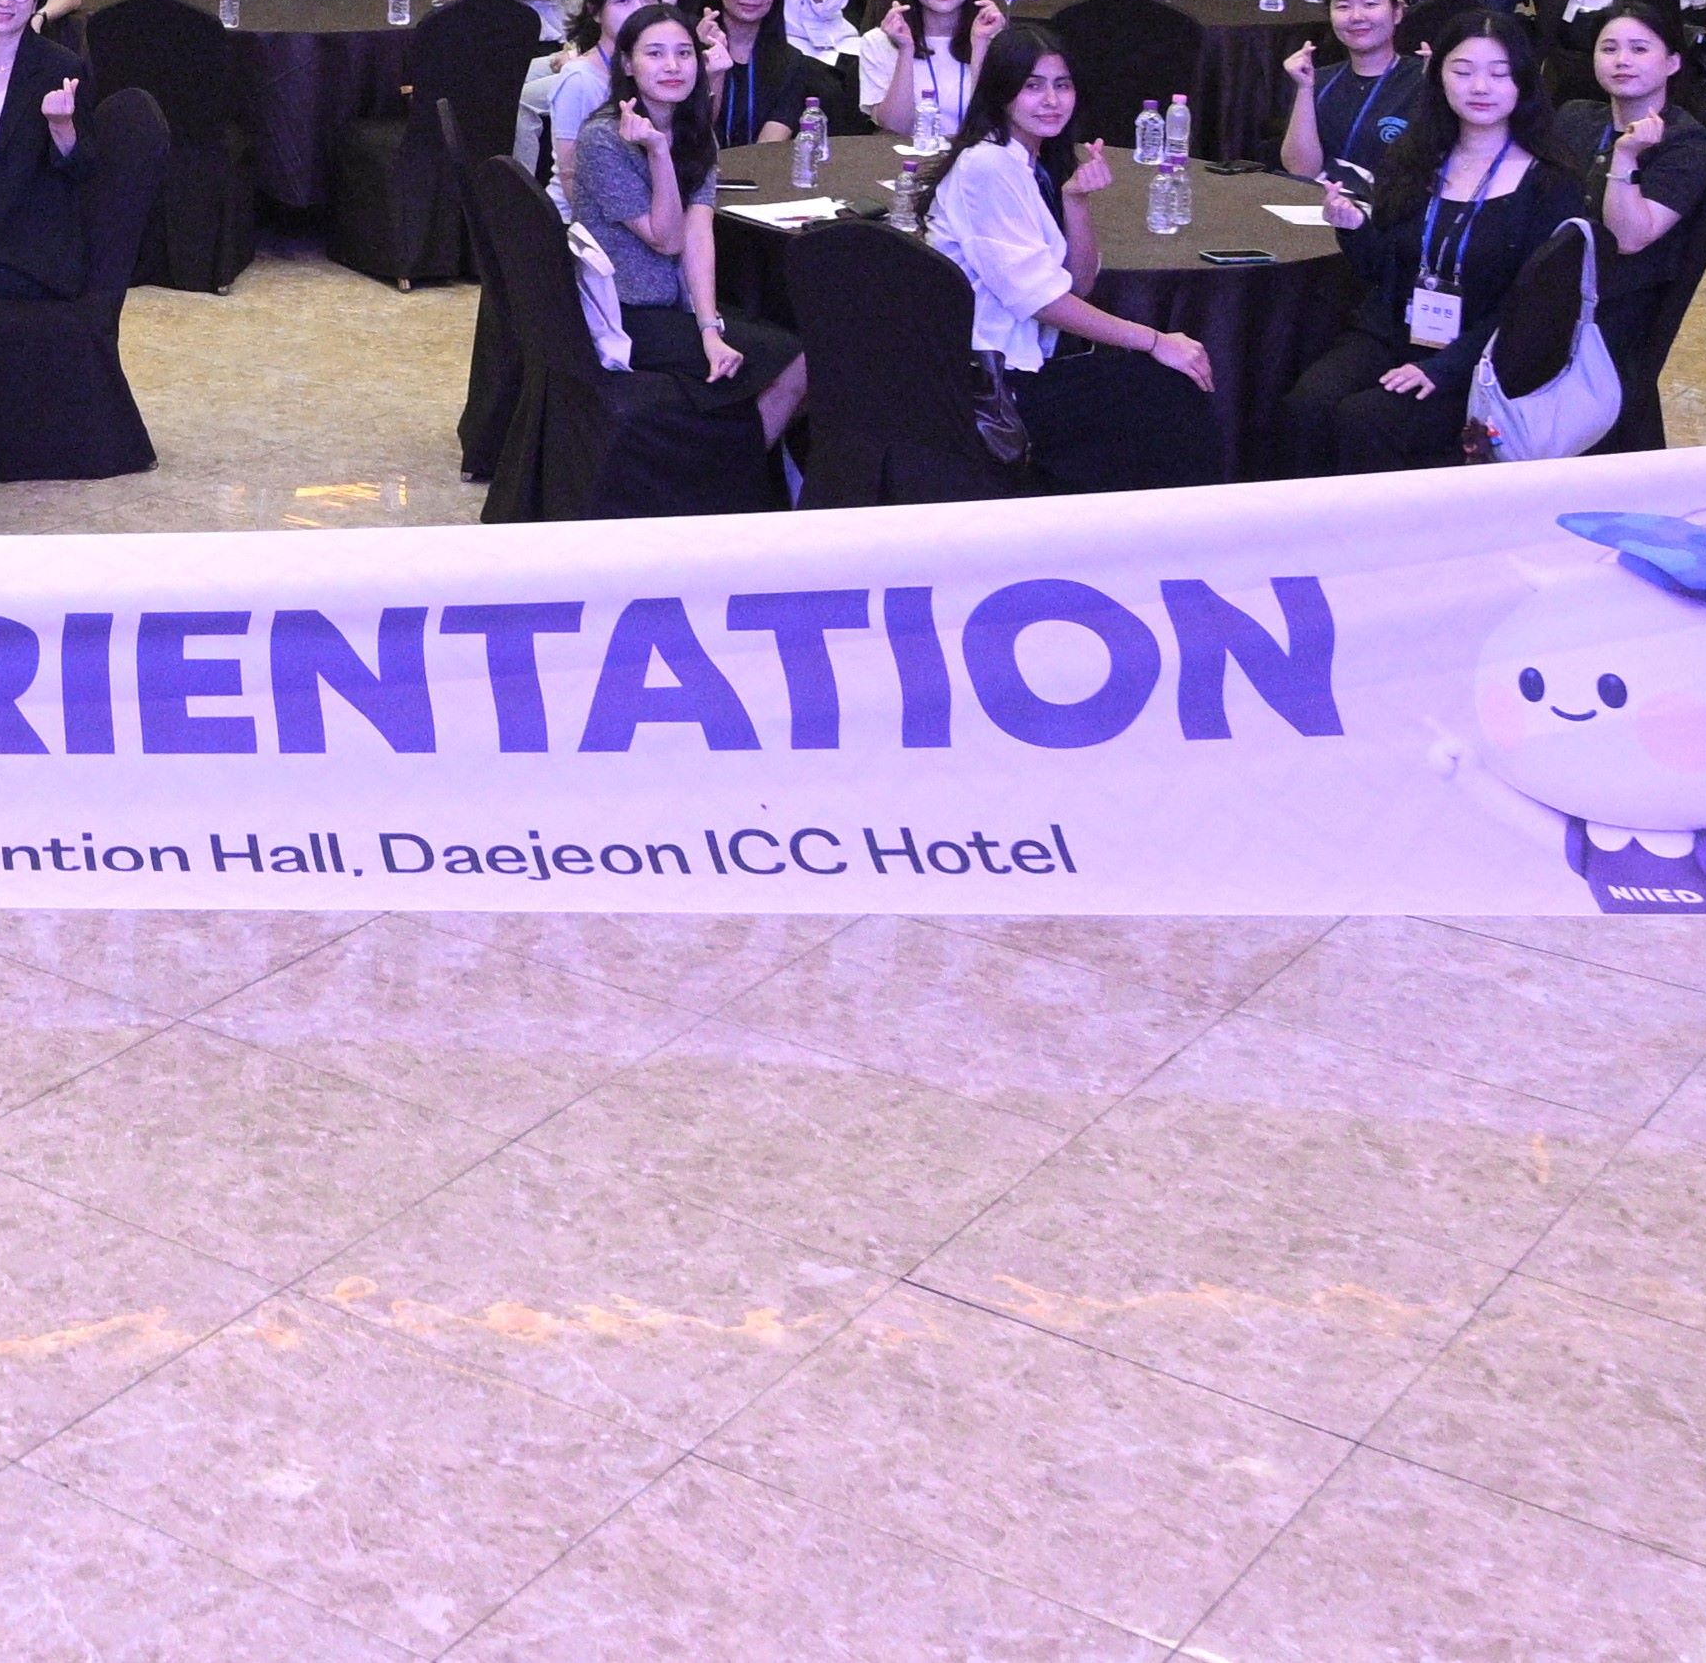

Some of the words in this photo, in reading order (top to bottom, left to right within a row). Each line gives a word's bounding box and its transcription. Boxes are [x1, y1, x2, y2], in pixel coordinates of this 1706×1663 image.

[210, 833, 362, 876] Hall,
[379, 831, 691, 880] Daejeon
[705, 828, 847, 874] ICC
[863, 825, 1076, 874] Hotel
[1608, 884, 1704, 904] NIIED
